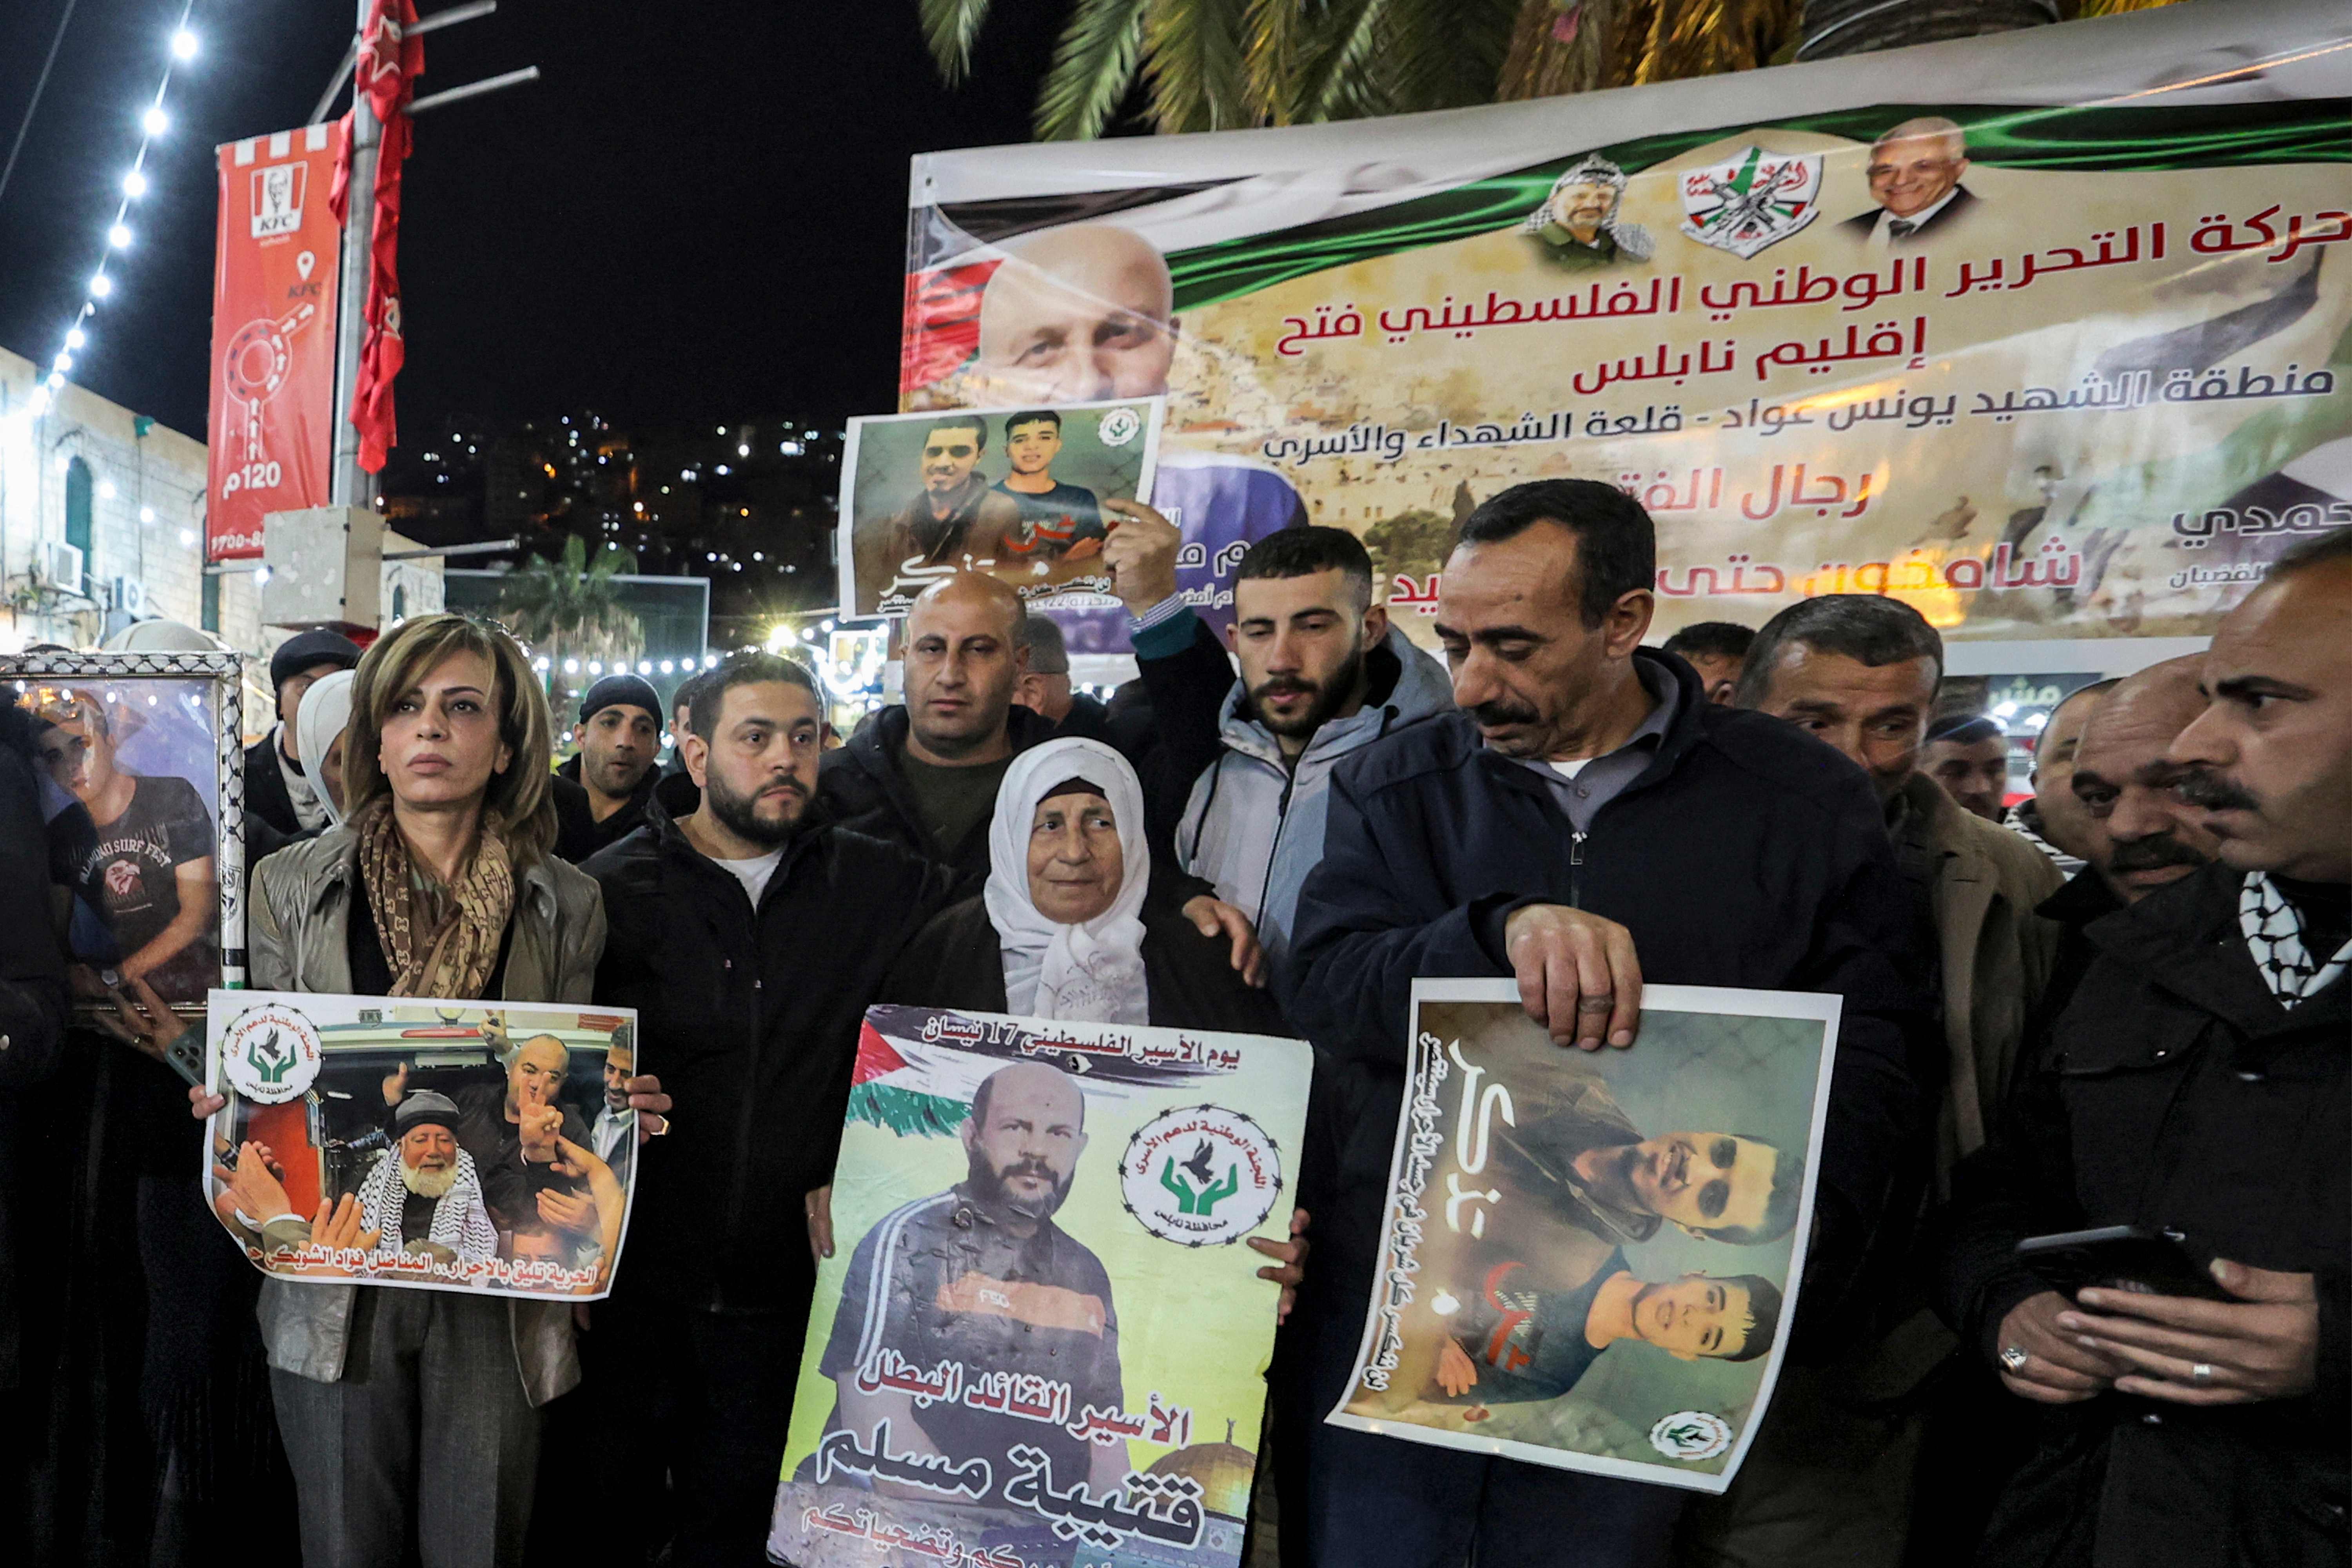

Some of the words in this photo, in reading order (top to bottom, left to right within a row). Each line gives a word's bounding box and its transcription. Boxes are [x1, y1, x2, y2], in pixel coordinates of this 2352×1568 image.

[260, 213, 293, 232] KFC
[2189, 205, 2352, 264] حركة
[1945, 221, 2164, 297] التحرير
[288, 282, 323, 298] KFC
[1700, 257, 1926, 317] الوطني
[1276, 303, 1362, 355] فتح
[1379, 276, 1682, 343] الفلسطيني
[1571, 339, 1737, 394] نابلس
[1756, 316, 1926, 380] إقليم
[1970, 370, 2148, 415] الشهيد
[2163, 366, 2334, 405] منطقة
[1416, 411, 1573, 449] الشهداء
[1584, 403, 1683, 437] قلعة
[1721, 397, 1815, 437] عواد
[1828, 389, 1957, 431] يونس
[1263, 424, 1406, 466] والأسرى
[1620, 467, 1723, 511] الفت
[1740, 463, 1873, 521] رجال
[1656, 554, 1786, 597] حتى
[1804, 535, 2081, 599] شامخون
[113, 839, 145, 853] SURF
[144, 843, 172, 868] FEST
[921, 1014, 984, 1047] نيسان
[986, 1021, 1019, 1044] 17
[1020, 1026, 1132, 1057] الفلسطيني
[1132, 1033, 1205, 1065] الأسير
[1206, 1047, 1241, 1071] يوم
[1163, 1120, 1198, 1143] لدعم
[1200, 1120, 1250, 1150] الوطنية
[1446, 1038, 1515, 1240] تذكر
[1135, 1135, 1162, 1175] الأسرى
[1245, 1146, 1267, 1189] اللجنة
[367, 1250, 433, 1273] المناضل
[512, 1259, 548, 1287] تليق
[548, 1262, 597, 1290] الحرية
[855, 1347, 963, 1409] البطل
[963, 1371, 1071, 1426] القائد
[1065, 1391, 1194, 1450] الأسير
[816, 1416, 994, 1500] مسلم
[1004, 1442, 1207, 1550] قتيبة
